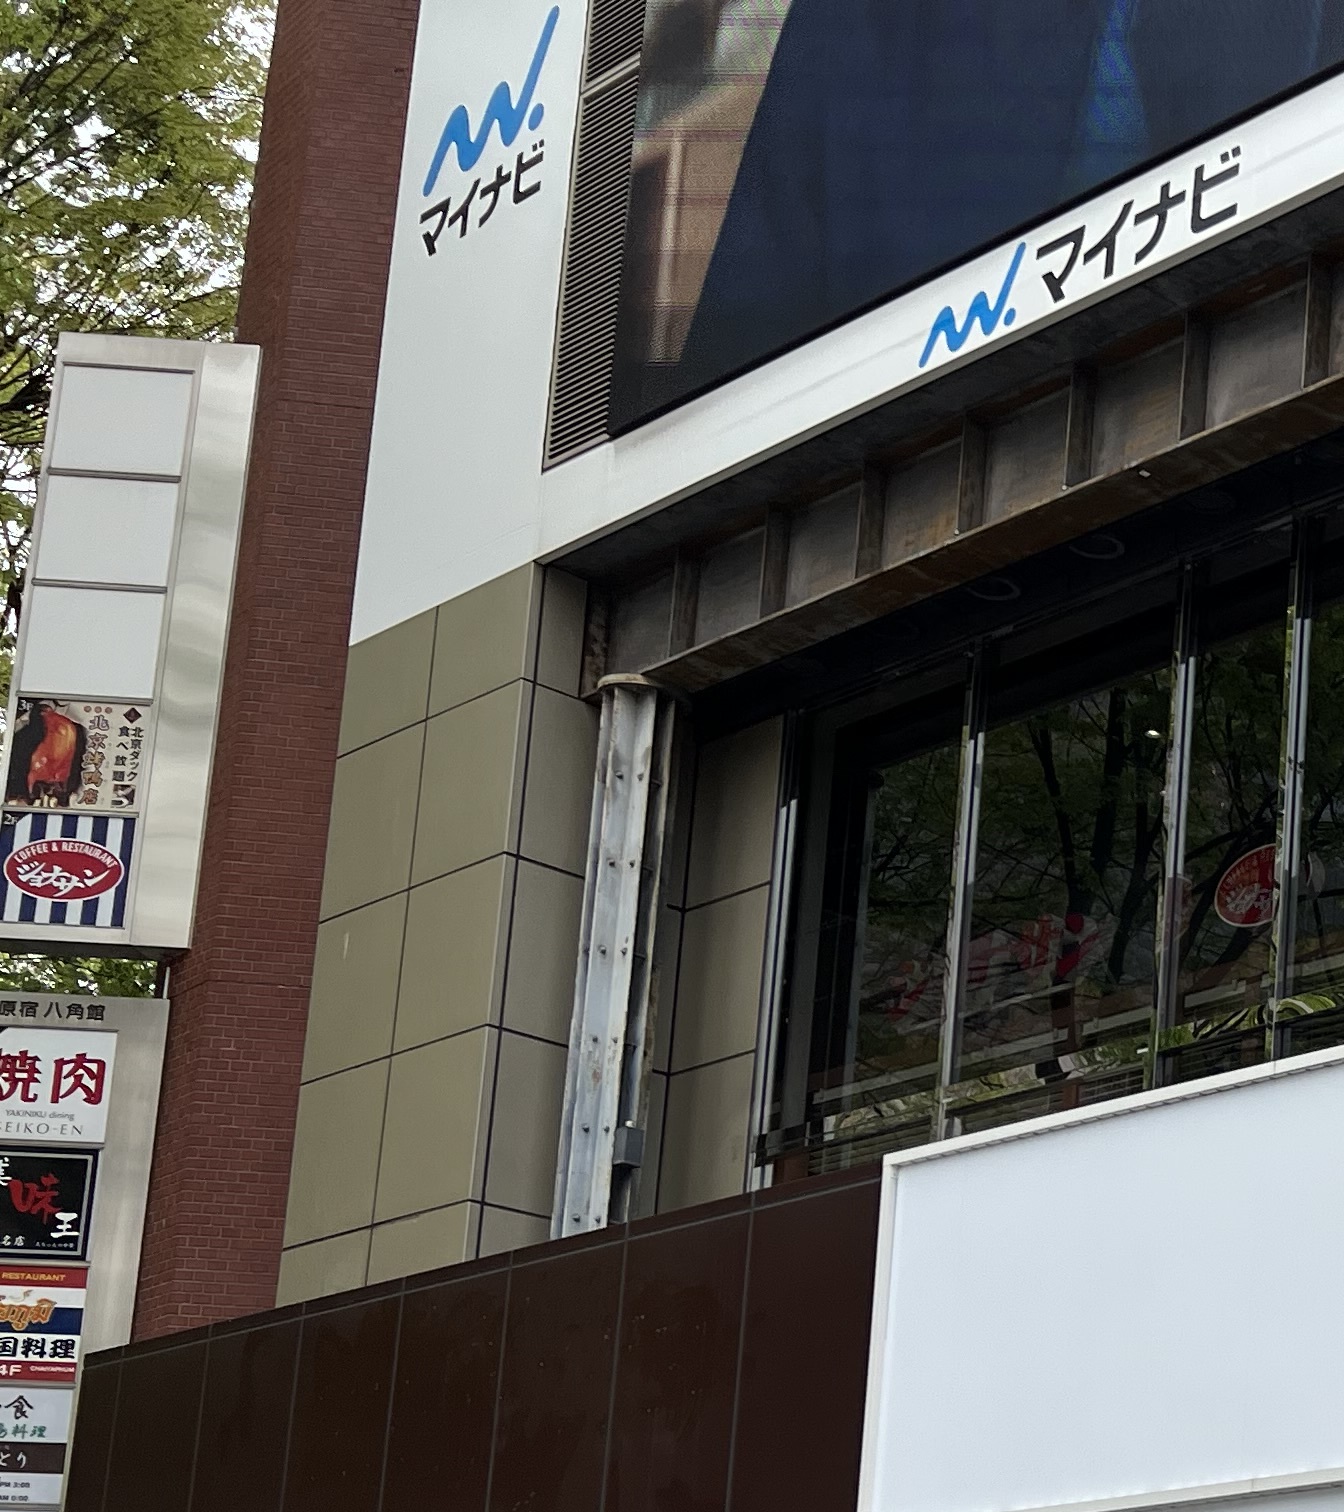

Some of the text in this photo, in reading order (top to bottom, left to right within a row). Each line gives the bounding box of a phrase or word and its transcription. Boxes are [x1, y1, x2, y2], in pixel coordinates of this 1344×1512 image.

[419, 139, 545, 256] マイナビ
[1036, 146, 1242, 303] マイナビ
[13, 842, 49, 863] COFFEE
[61, 842, 118, 868] RESTAURANT
[0, 1048, 107, 1106] 焼肉
[0, 1121, 83, 1136] EIKO-EN
[2, 1271, 66, 1281] RESTAURANT
